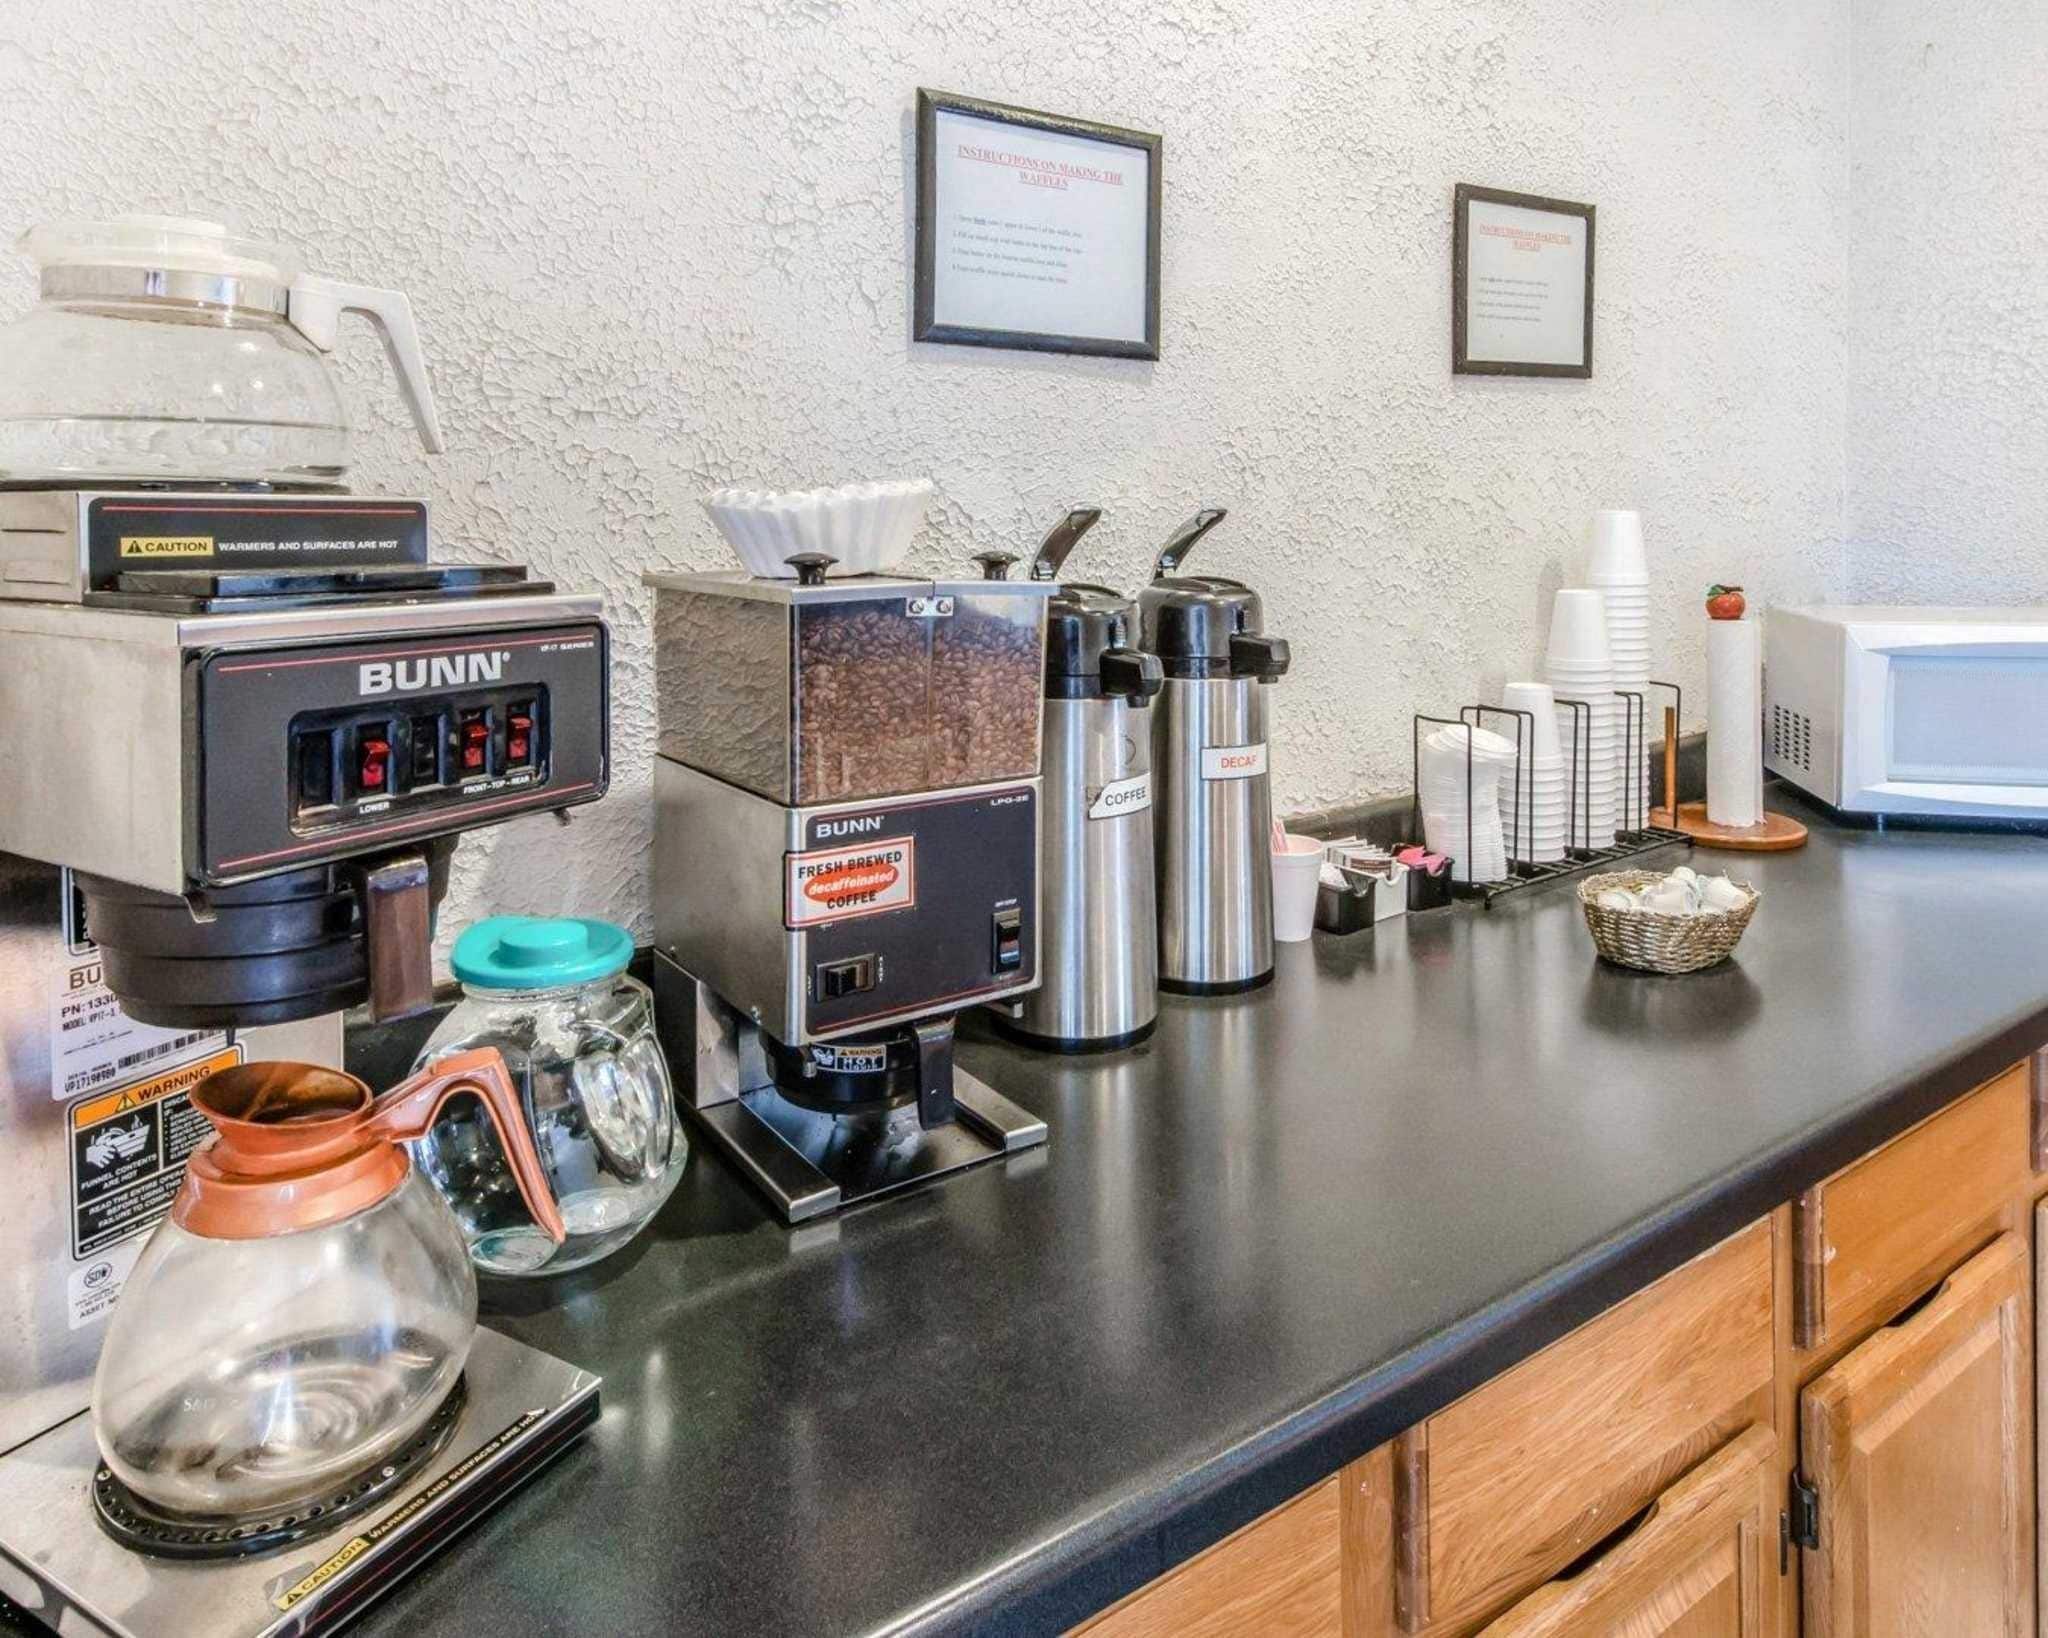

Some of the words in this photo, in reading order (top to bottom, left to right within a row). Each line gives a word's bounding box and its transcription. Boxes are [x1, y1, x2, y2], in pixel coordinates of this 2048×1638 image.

[958, 144, 1039, 168] INSTRUCTIONS
[1040, 159, 1057, 171] ON
[1059, 161, 1100, 179] MAKING
[1103, 170, 1122, 185] THE
[1019, 171, 1069, 188] WAFFLES
[145, 541, 208, 552] CAUTION
[218, 541, 276, 552] WARMERS
[278, 541, 301, 551] AND
[302, 541, 355, 551] SURFACES
[357, 540, 377, 549] ARE
[378, 540, 398, 549] HOT
[359, 652, 501, 696] BUNN
[1221, 755, 1257, 768] DECAF
[359, 802, 390, 814] LOWER
[1105, 786, 1147, 806] COFFEE
[816, 816, 881, 838] BUNN
[798, 860, 843, 879] FRESH
[847, 851, 903, 870] BREWED
[808, 869, 895, 896] decaffeinated
[826, 890, 877, 910] COFFEE
[138, 1065, 211, 1101] WARNING
[81, 1172, 114, 1190] FUNNEL
[115, 1153, 158, 1176] CONTENTS
[103, 1177, 120, 1190] ARE
[120, 1169, 138, 1182] HOT
[89, 1200, 112, 1216] READ
[112, 1193, 129, 1204] THE
[130, 1181, 158, 1198] ENTIRE
[106, 1197, 139, 1216] BEFORE
[140, 1186, 165, 1201] USING
[98, 1210, 132, 1228] FAILURE
[133, 1203, 144, 1213] TO
[302, 1541, 362, 1590] CAUTION
[369, 1497, 425, 1538] WARMERS
[427, 1481, 449, 1497] AND
[449, 1441, 500, 1481] SURFACES
[500, 1426, 520, 1443] ARE
